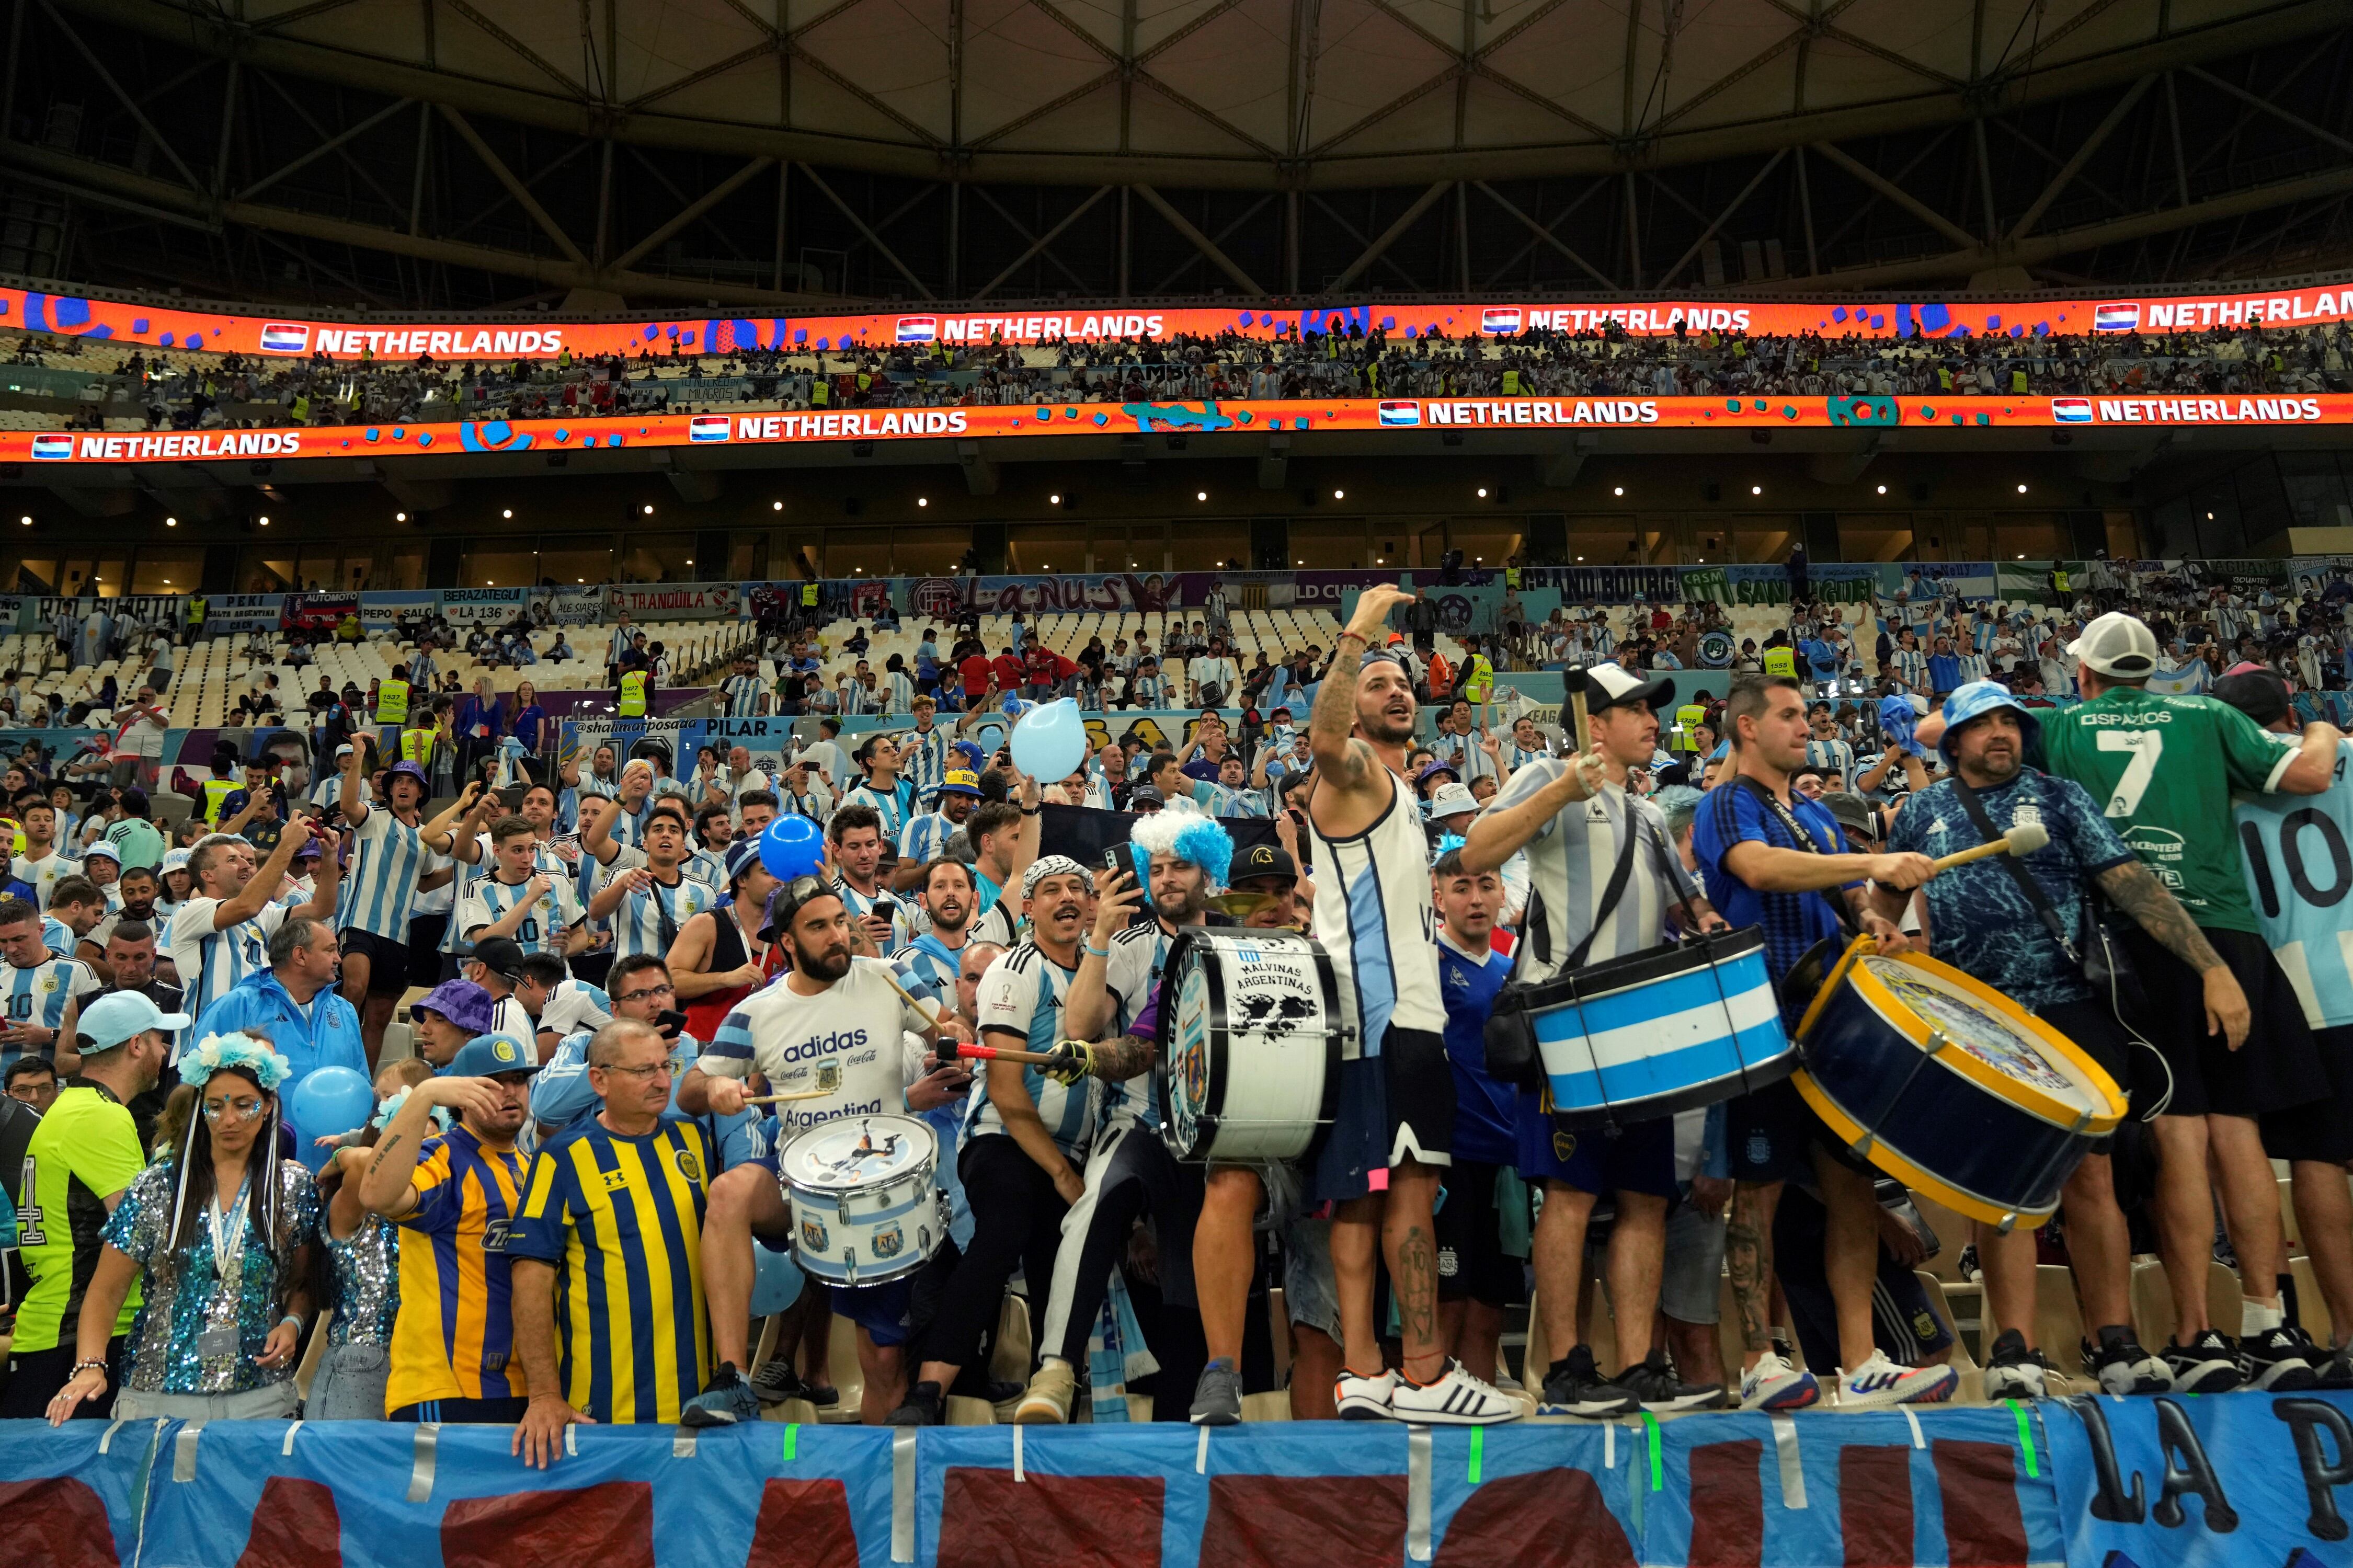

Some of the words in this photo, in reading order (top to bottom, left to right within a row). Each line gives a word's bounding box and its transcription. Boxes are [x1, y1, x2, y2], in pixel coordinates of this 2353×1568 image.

[944, 316, 1163, 340] NETHERLANDS
[1528, 309, 1750, 331] NETHERLANDS
[316, 329, 562, 353] NETHERLANDS
[689, 388, 733, 399] MILAGROS
[1428, 401, 1658, 423] NETHERLANDS
[2098, 399, 2321, 421] NETHERLANDS
[738, 412, 967, 440] NETHERLANDS
[79, 432, 300, 459] NETHERLANDS
[1684, 573, 1723, 586] CASM
[2233, 576, 2269, 585] COUNTRY
[227, 596, 264, 606] PEKI
[305, 593, 358, 603] AUTOMOTO
[444, 589, 521, 602] BERAZATEGUI
[612, 592, 625, 607] LA
[631, 591, 705, 610] TRANQUILA
[1737, 579, 1787, 608] SAN
[234, 609, 275, 617] ARGENTINA
[363, 609, 392, 619] PEPO
[460, 608, 474, 617] LA
[480, 608, 502, 617] 136
[557, 604, 573, 614] ALE
[1908, 663, 1916, 672] 10
[574, 718, 697, 734] @shalimarposada
[707, 719, 767, 736] PILAR
[921, 747, 935, 761] 10
[1827, 755, 1841, 768] 10
[2096, 729, 2163, 817] 7
[1774, 803, 1808, 841] adidas
[2240, 807, 2353, 919] 10
[1241, 963, 1301, 977] MALVINAS
[1237, 975, 1313, 995] ARGENTINAS
[4, 993, 33, 1018] 10
[784, 1028, 868, 1063] adidas
[2069, 1393, 2240, 1533] LA
